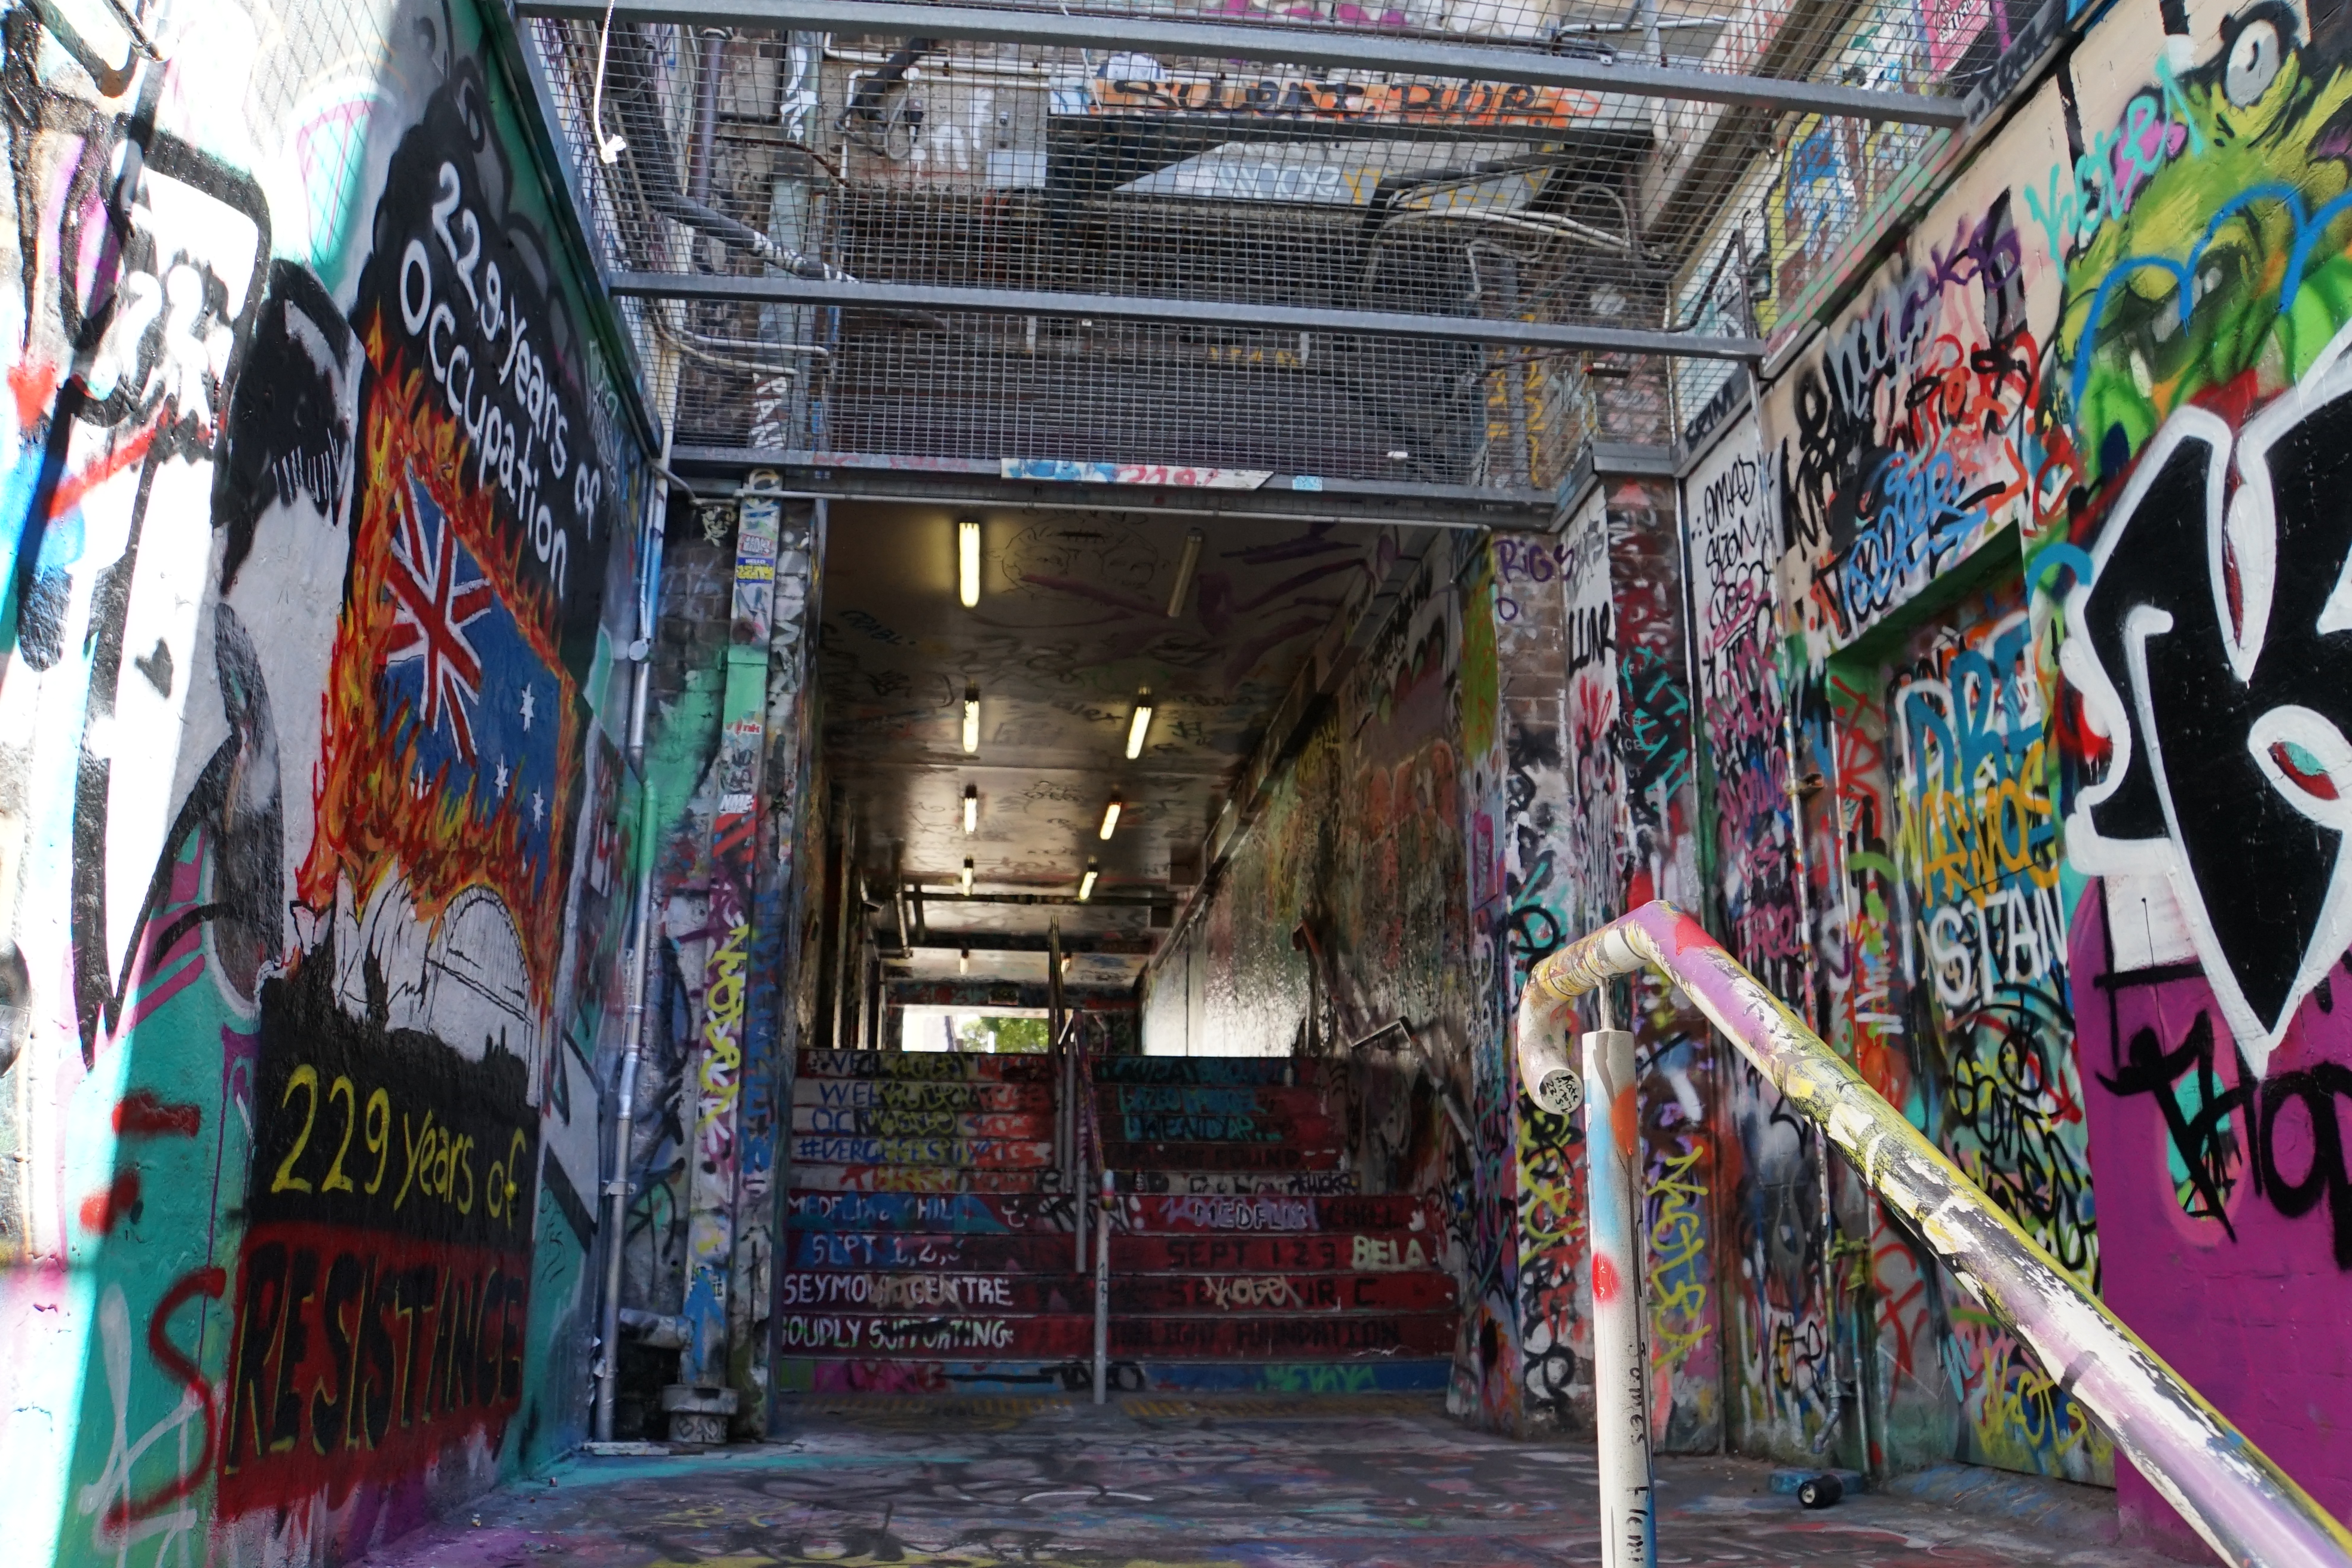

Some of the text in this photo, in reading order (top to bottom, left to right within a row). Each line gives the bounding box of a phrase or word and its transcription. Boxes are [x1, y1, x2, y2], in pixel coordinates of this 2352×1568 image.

[431, 161, 503, 342] 229
[574, 463, 601, 541] of
[1560, 1074, 1578, 1102] Kate
[271, 1064, 391, 1195] 229
[486, 1128, 528, 1231] of
[1166, 1239, 1249, 1267] SEPT
[1352, 1235, 1429, 1270] BELA
[223, 1239, 524, 1476] RESISTANCE
